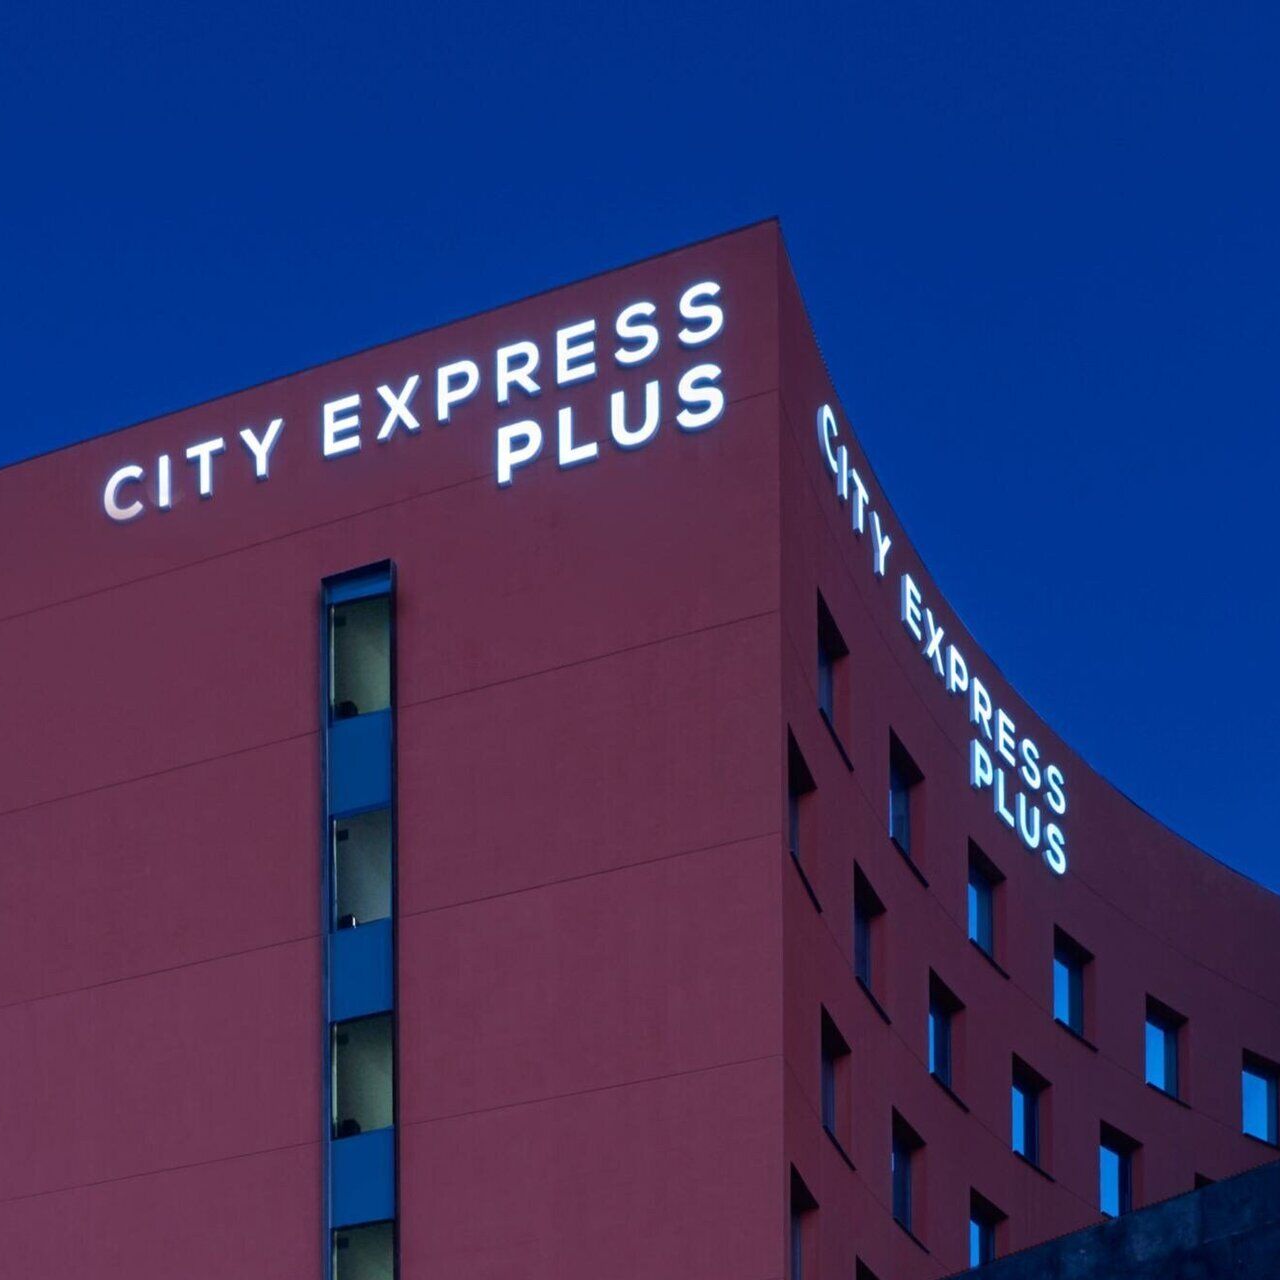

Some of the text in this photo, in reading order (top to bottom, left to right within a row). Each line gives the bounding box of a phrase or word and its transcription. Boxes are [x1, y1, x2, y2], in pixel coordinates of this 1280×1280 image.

[102, 280, 725, 522] CITY EXPRESS
[496, 362, 726, 487] PLUS
[816, 403, 1067, 817] CITY EXPRESS
[970, 736, 1068, 877] PLUS
